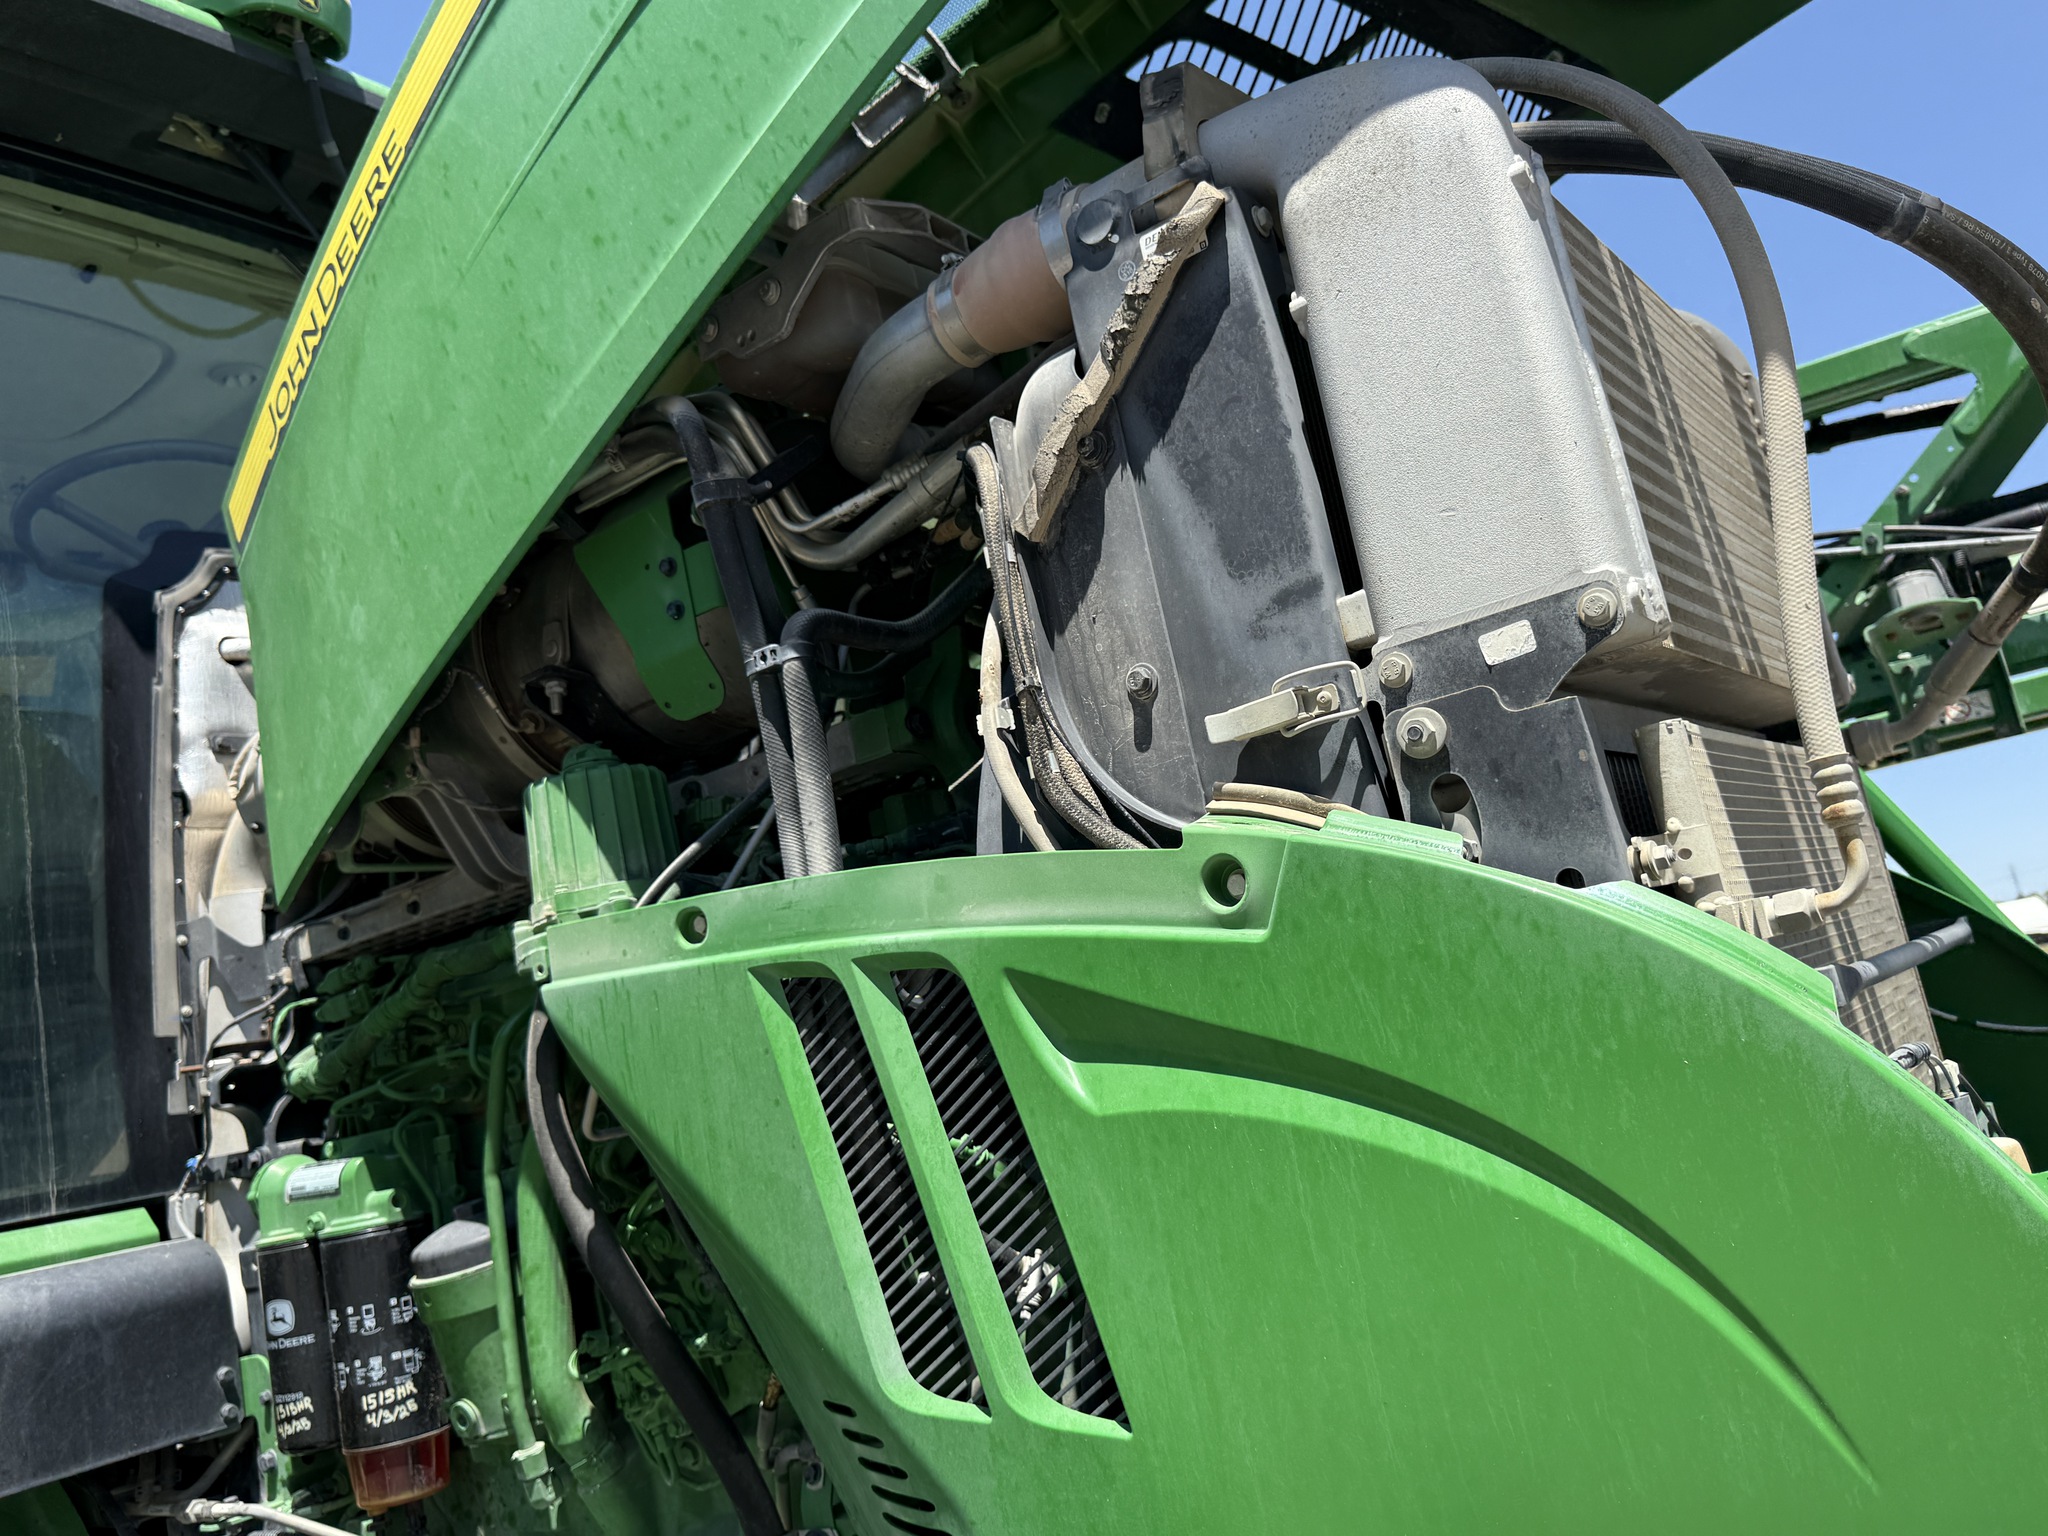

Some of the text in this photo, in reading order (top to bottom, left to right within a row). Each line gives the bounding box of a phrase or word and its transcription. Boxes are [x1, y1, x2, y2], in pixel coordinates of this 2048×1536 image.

[268, 128, 404, 450] JOHN DEERE
[278, 1333, 316, 1349] DEERE
